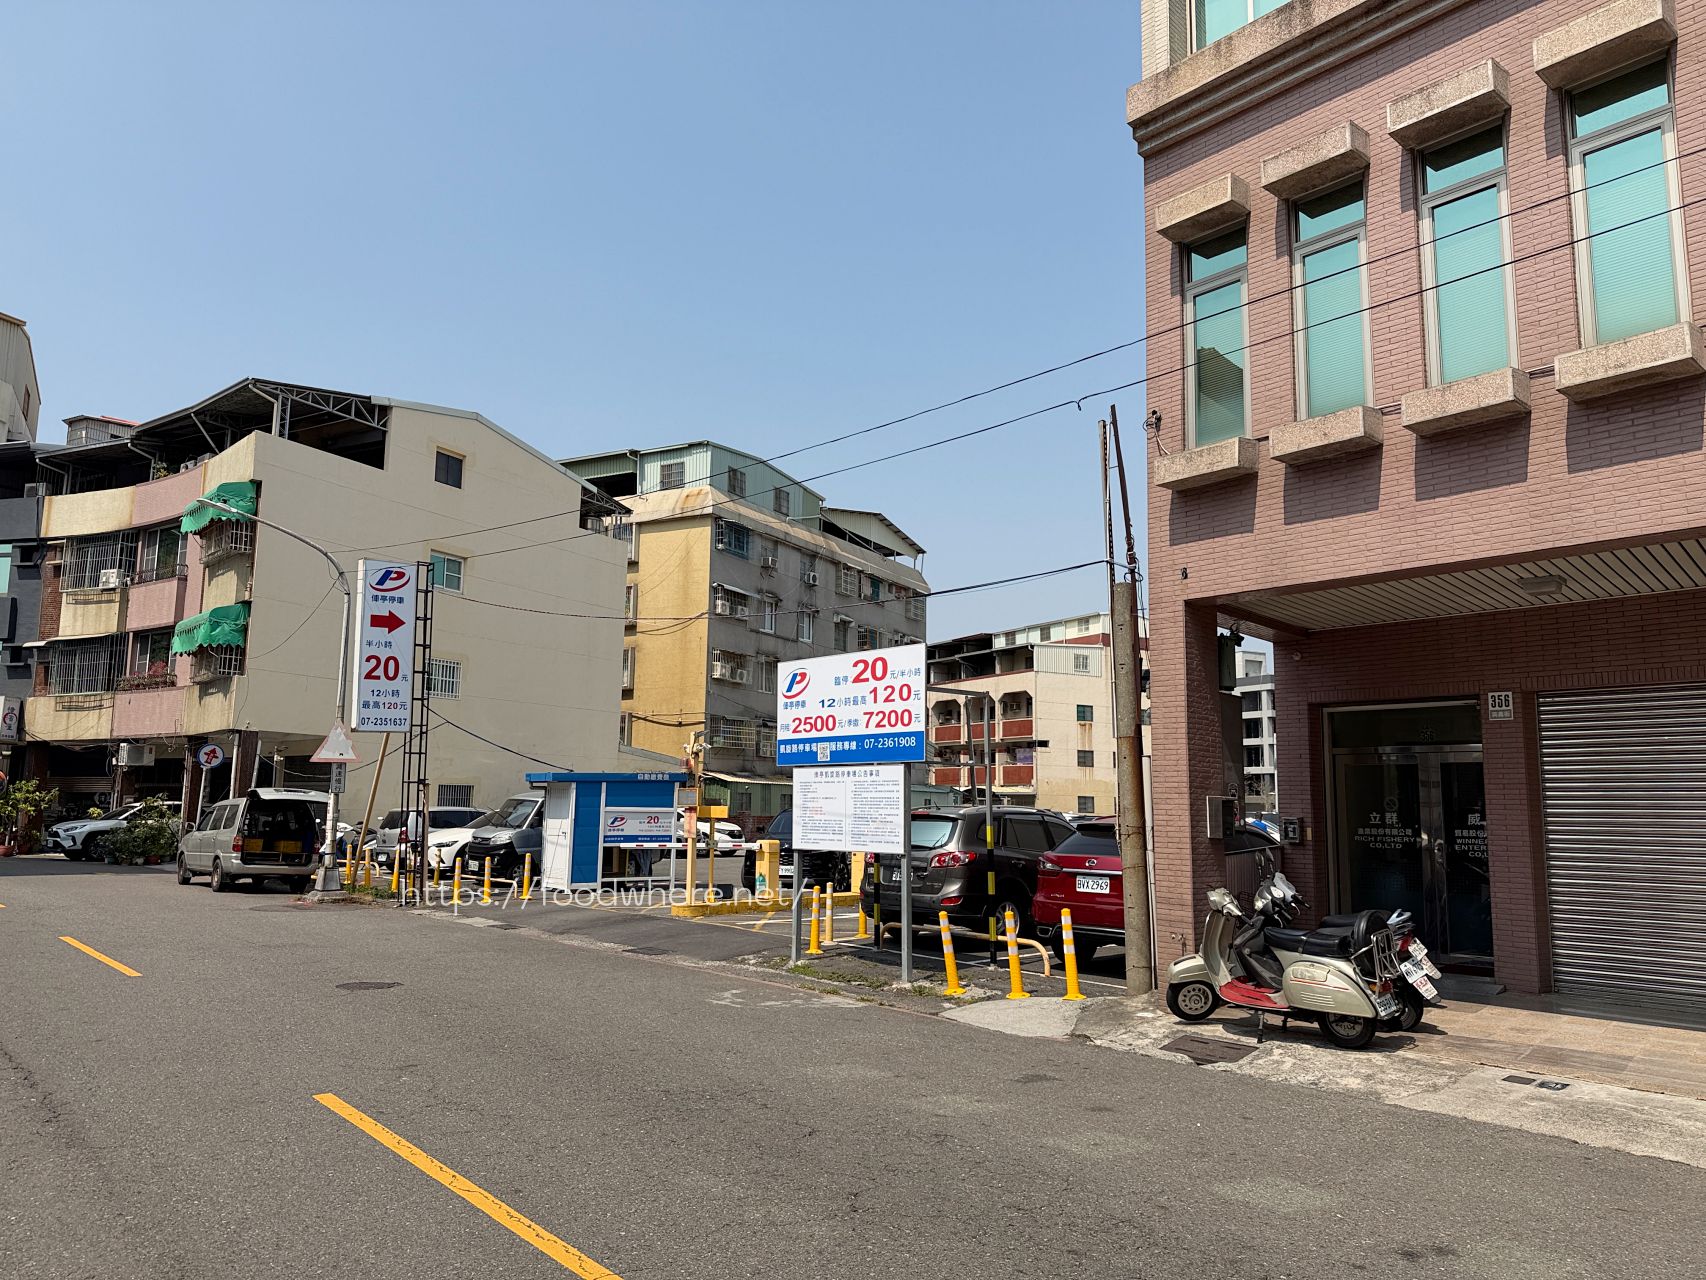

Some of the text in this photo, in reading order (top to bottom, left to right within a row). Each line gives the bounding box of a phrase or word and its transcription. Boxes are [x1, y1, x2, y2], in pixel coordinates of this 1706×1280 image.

[365, 639, 393, 649] 半小時
[370, 689, 400, 698] 12小時
[361, 700, 408, 711] 最高120元
[1490, 694, 1510, 708] 356
[360, 717, 407, 727] 07-2351637
[1377, 836, 1415, 844] FISHERY
